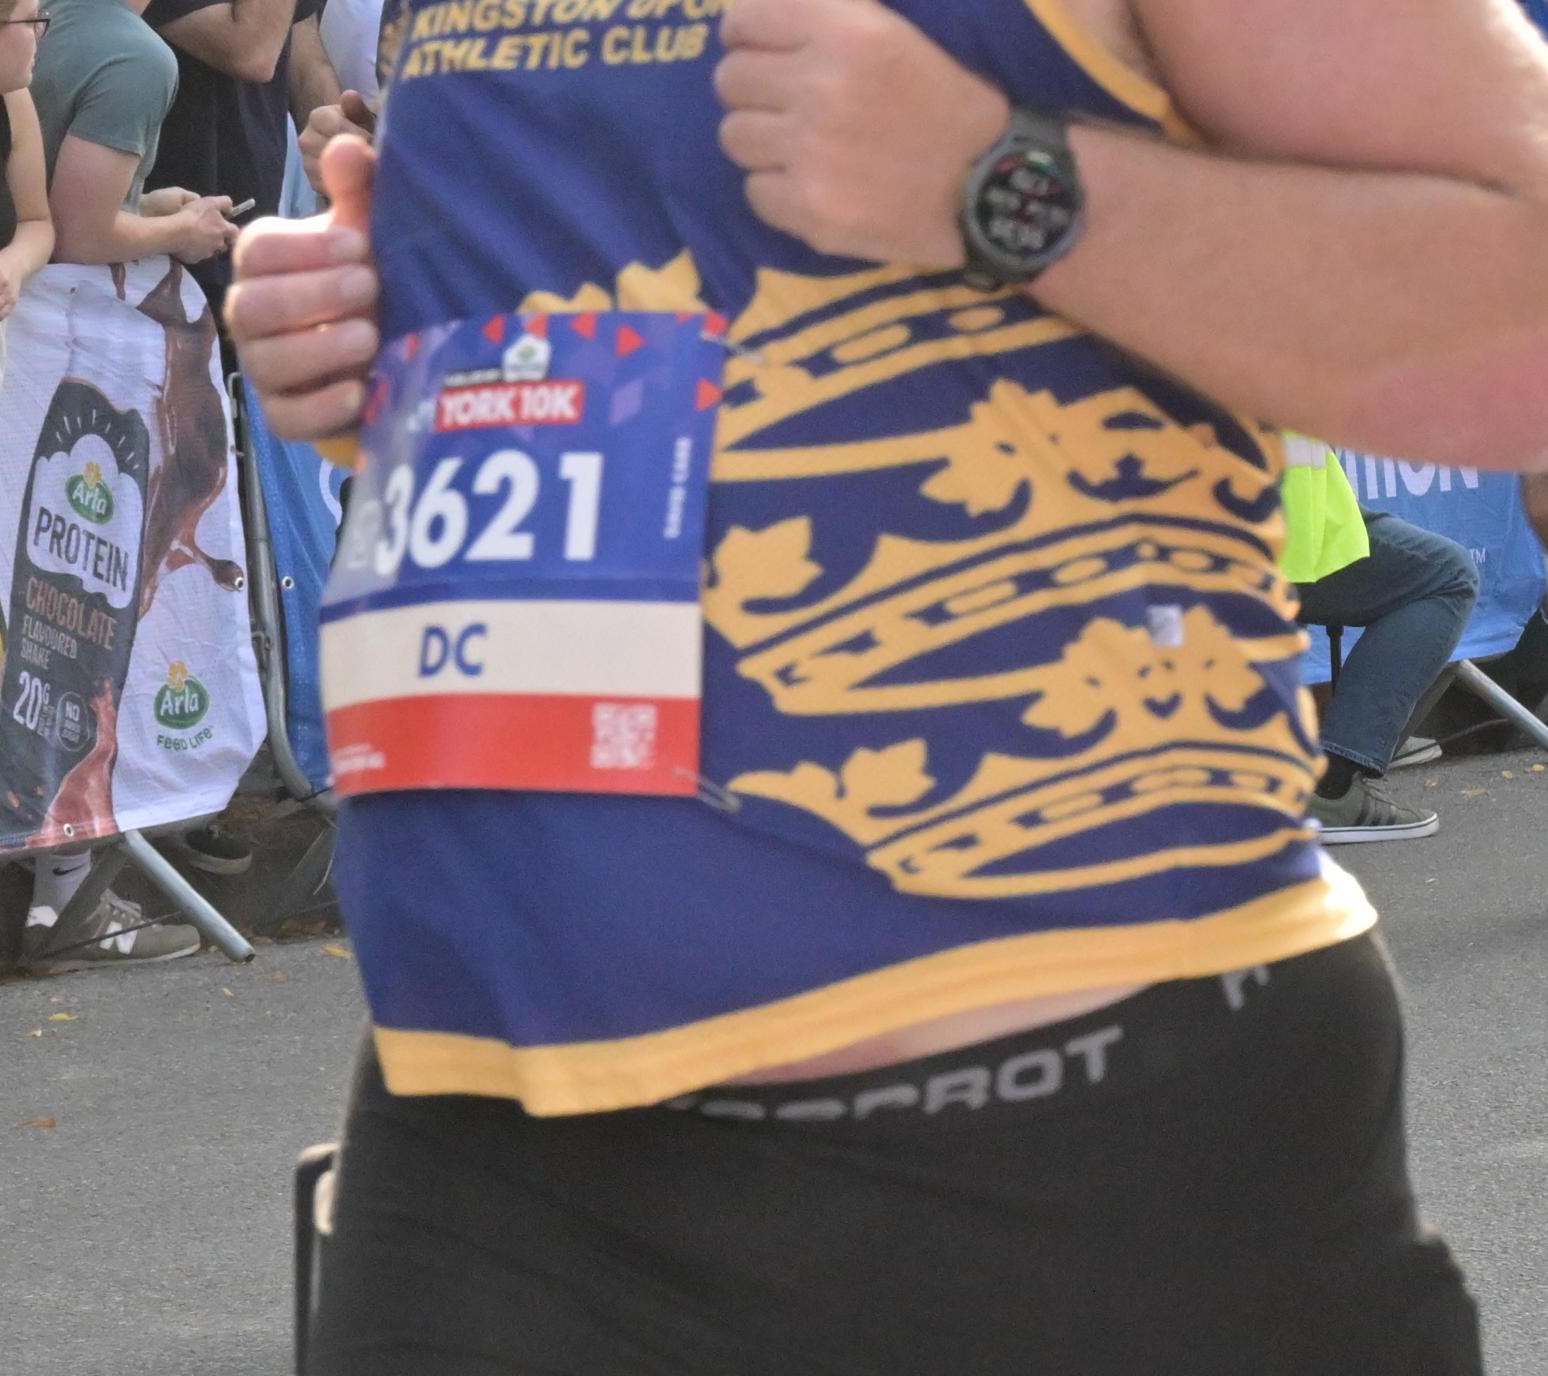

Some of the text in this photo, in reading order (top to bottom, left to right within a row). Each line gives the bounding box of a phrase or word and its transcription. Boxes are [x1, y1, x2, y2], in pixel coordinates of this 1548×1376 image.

[404, 24, 709, 81] ATHLETIC CLUB
[441, 383, 579, 428] YORK 10K
[72, 480, 107, 516] Arla
[375, 450, 603, 576] 3621
[34, 506, 129, 593] PROTEIN
[26, 576, 117, 651] CHOCOLATE
[20, 637, 52, 670] SHAKE
[22, 614, 78, 660] FLAVOURED
[417, 622, 488, 679] DC
[65, 701, 80, 722] NO
[160, 685, 200, 717] Arla
